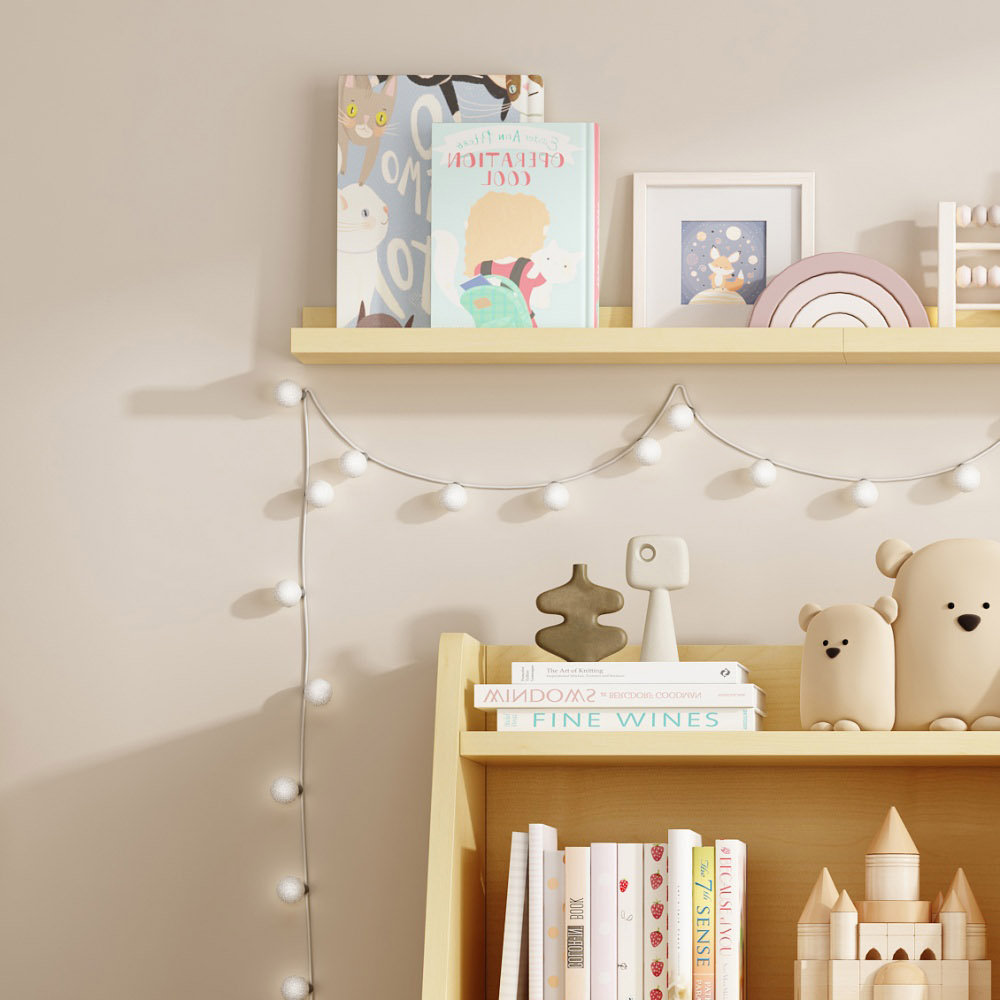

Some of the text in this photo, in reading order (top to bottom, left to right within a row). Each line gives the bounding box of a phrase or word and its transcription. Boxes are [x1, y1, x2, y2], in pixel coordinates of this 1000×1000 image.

[533, 712, 601, 728] FINE
[616, 712, 719, 728] WINES
[696, 905, 711, 967] SENSE
